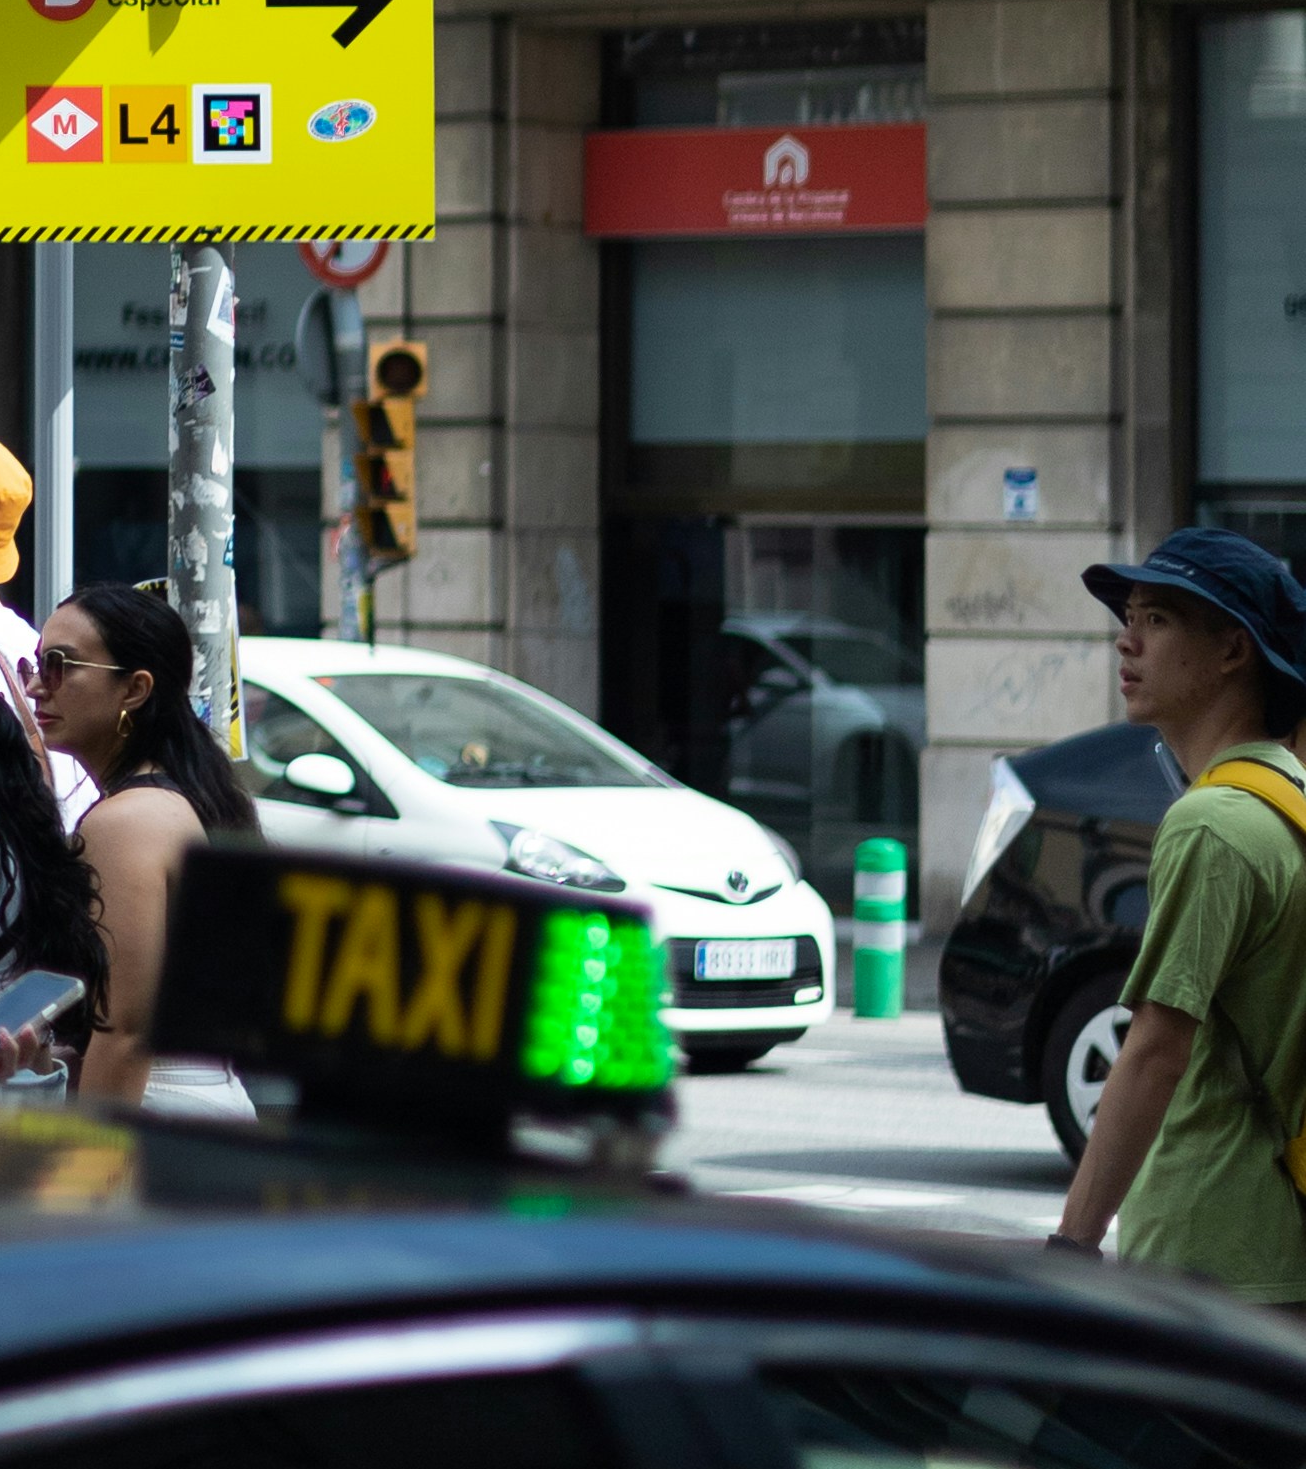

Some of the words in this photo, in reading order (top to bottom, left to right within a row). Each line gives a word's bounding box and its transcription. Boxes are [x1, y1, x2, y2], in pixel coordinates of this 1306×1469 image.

[53, 114, 77, 135] M
[119, 103, 180, 144] L4
[277, 870, 518, 1061] TAXI
